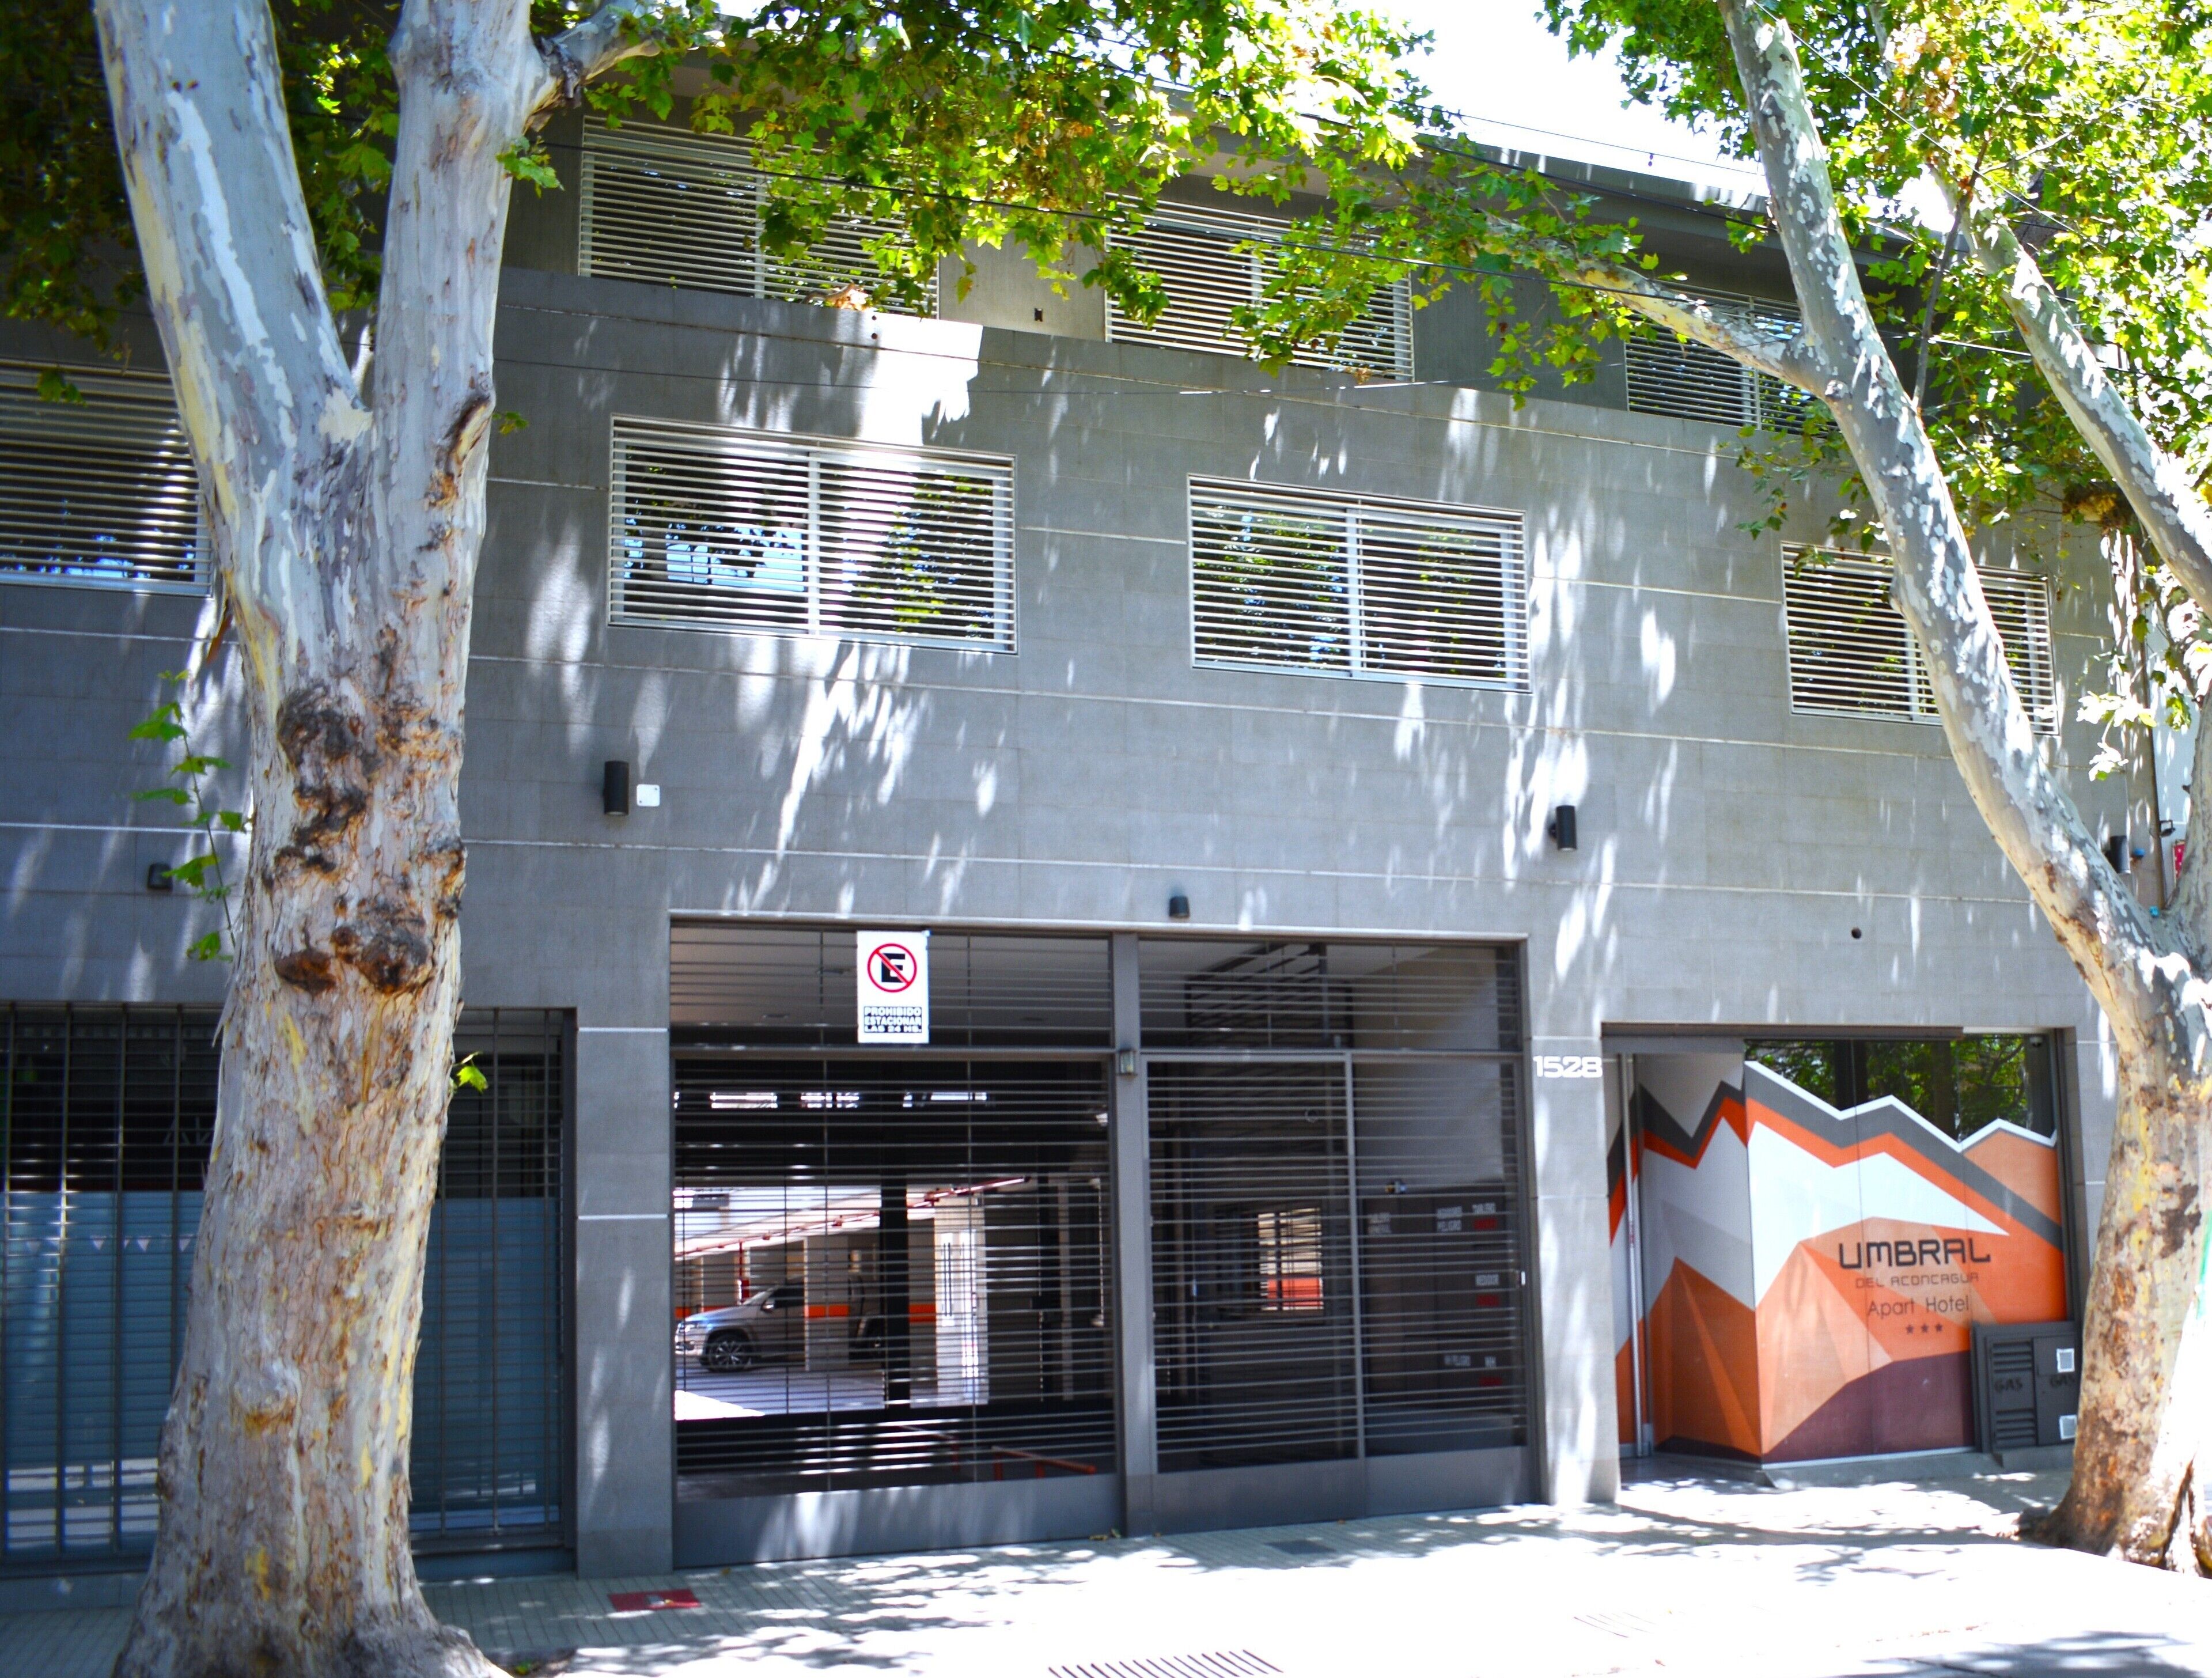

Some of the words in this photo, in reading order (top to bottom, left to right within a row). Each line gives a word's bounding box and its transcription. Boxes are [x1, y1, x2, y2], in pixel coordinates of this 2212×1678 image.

[881, 953, 906, 983] E
[864, 1007, 921, 1016] PROHIBIDO
[864, 1016, 921, 1025] ESTACIONAR
[1533, 1055, 1603, 1078] 1528
[1839, 1238, 1991, 1270] UMBRAL
[1856, 1277, 1884, 1288] DEL
[1891, 1272, 1979, 1287] ACONCAGUA
[1868, 1298, 1914, 1319] Apart
[1926, 1294, 1969, 1312] Hotel
